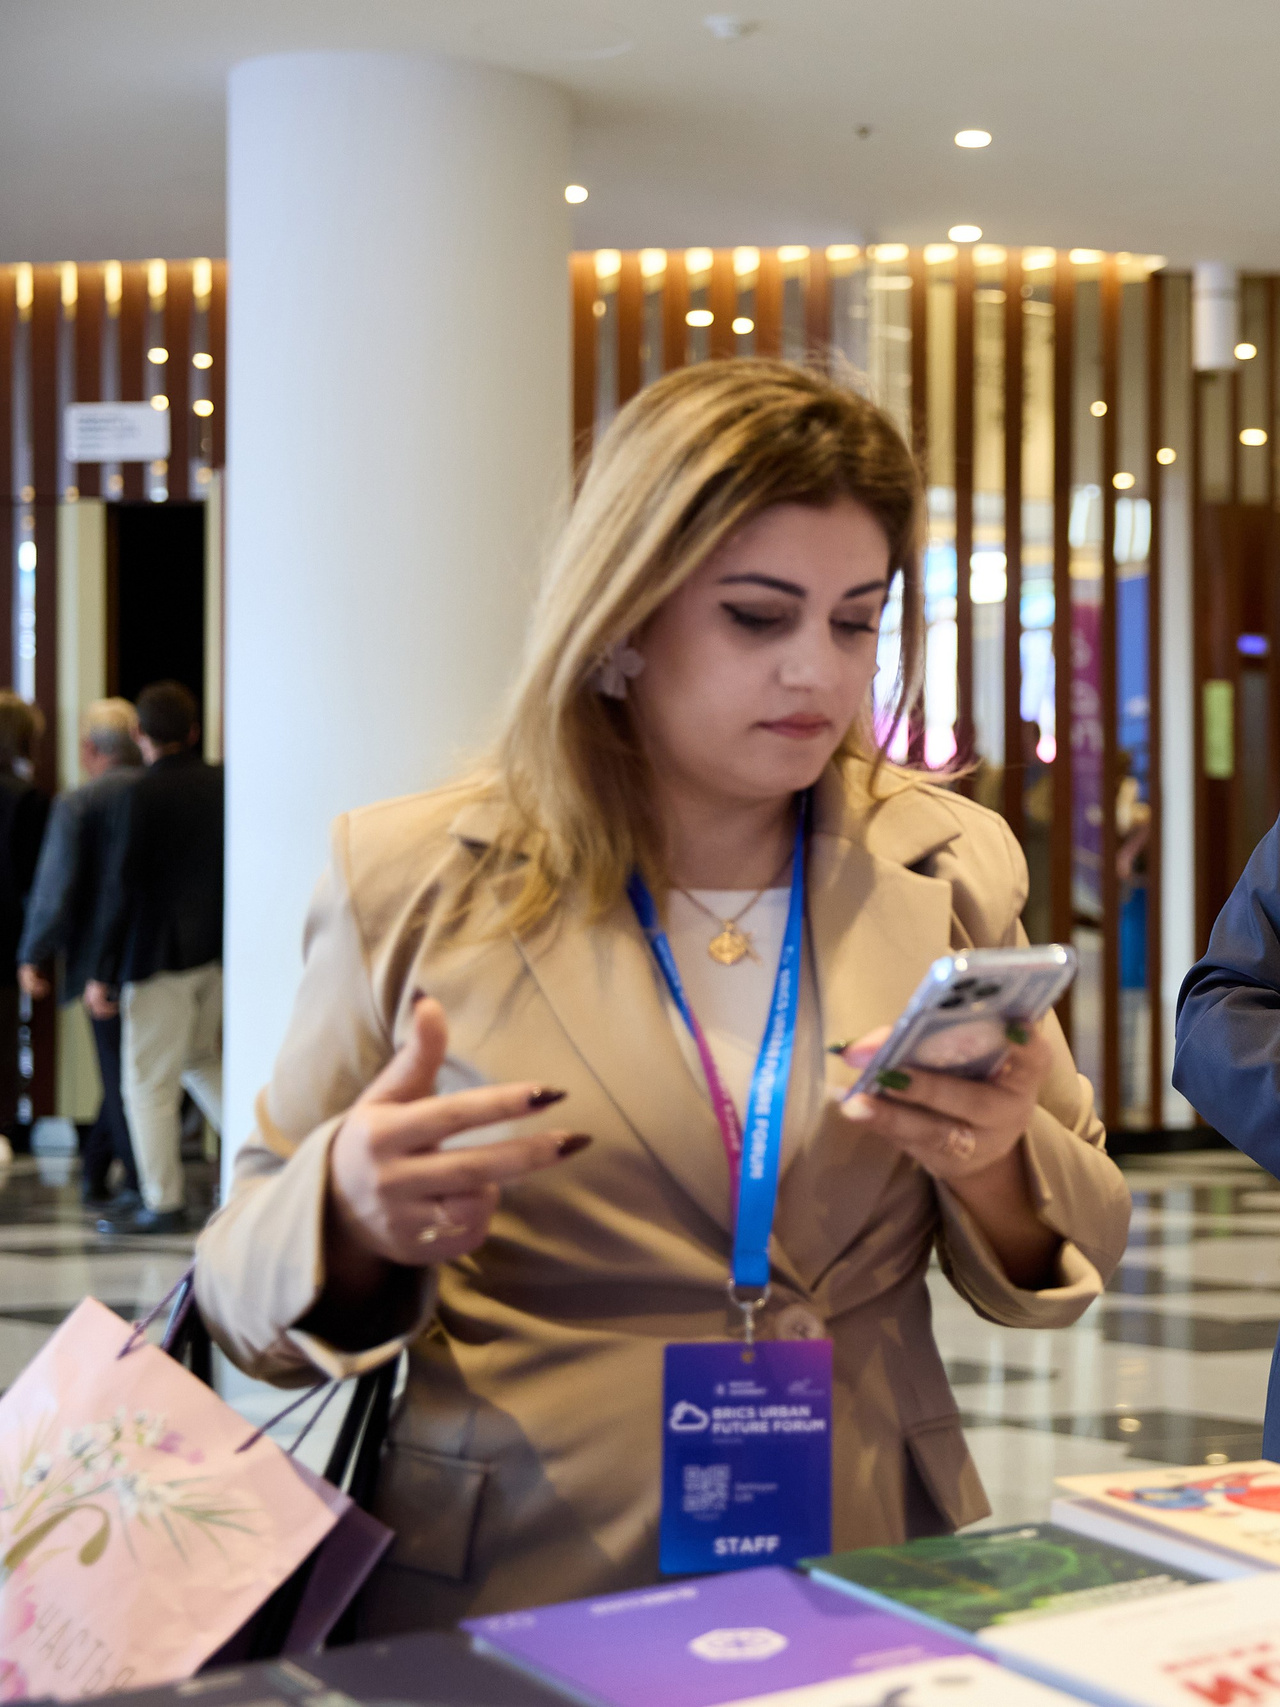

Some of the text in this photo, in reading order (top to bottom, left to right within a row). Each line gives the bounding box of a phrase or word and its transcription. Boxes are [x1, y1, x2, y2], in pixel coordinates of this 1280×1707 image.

[712, 1405, 812, 1420] BRICS URBAN
[712, 1418, 826, 1434] FUTURE FORUM
[714, 1535, 781, 1556] STAFF
